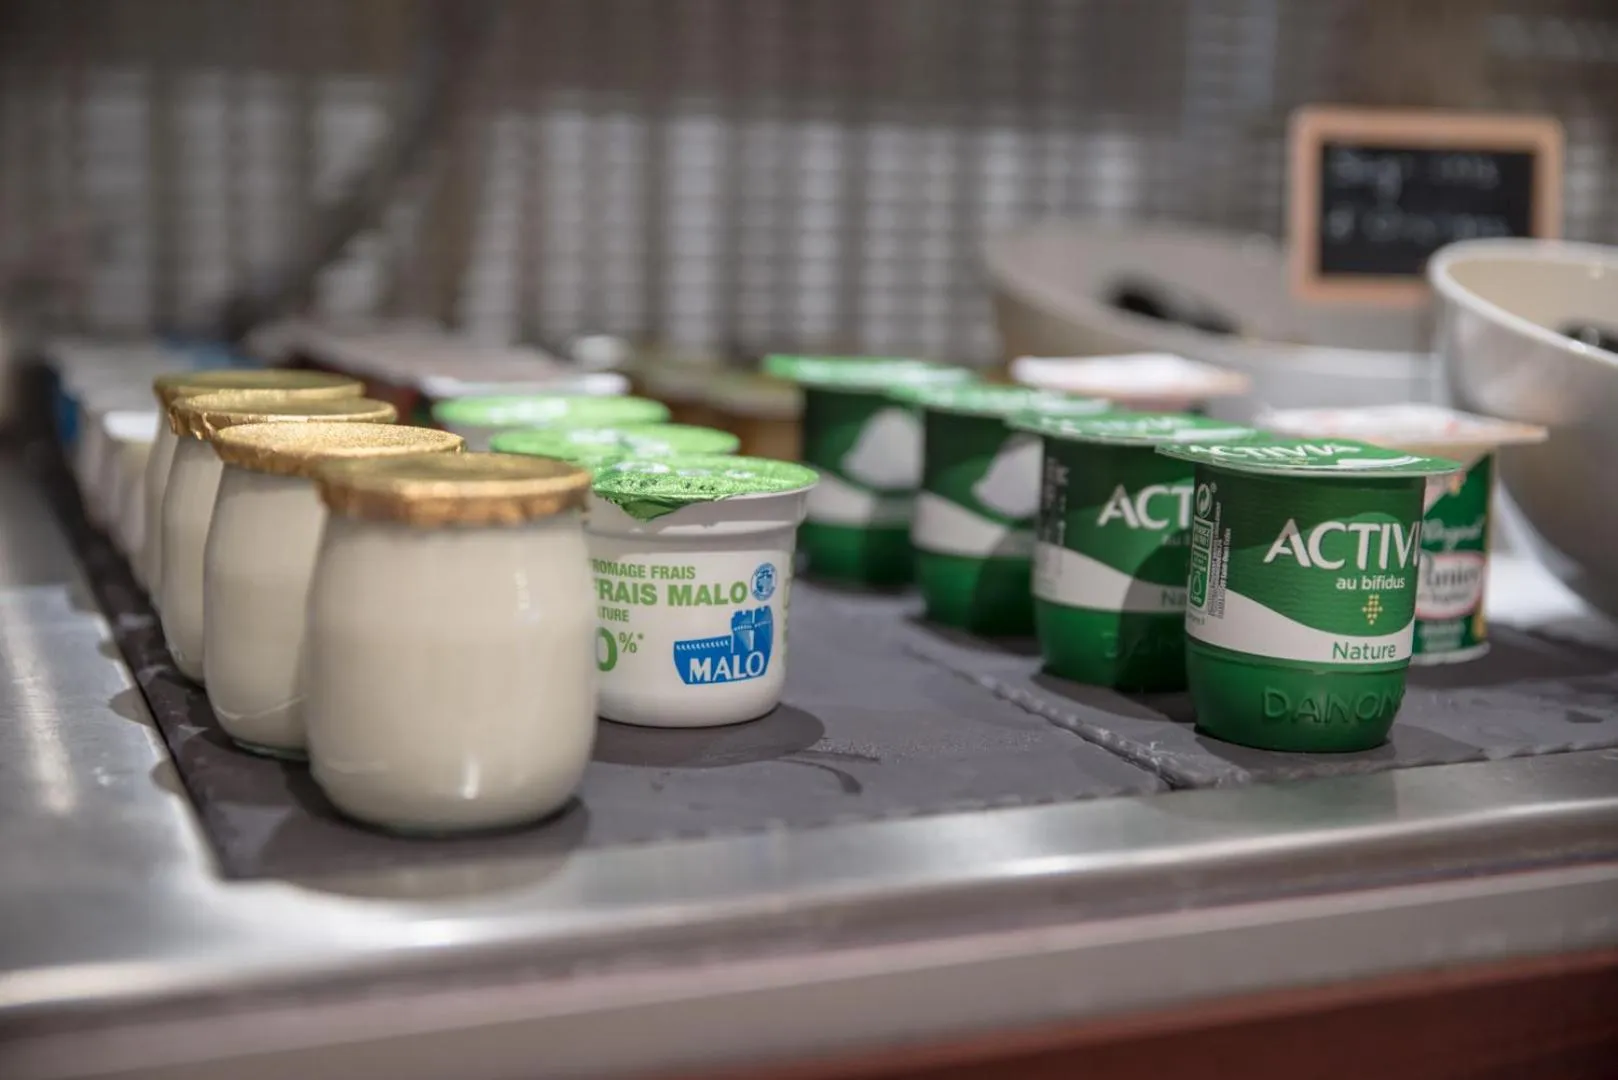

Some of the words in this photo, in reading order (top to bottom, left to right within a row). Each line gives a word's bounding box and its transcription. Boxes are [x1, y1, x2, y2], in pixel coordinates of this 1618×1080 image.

[1097, 484, 1195, 530] ACT
[591, 558, 646, 579] ROMAGE
[651, 565, 696, 580] FRAIS
[667, 581, 748, 607] MALO
[1336, 578, 1357, 591] au
[1361, 574, 1406, 591] bifidus
[597, 605, 630, 623] TURE
[1332, 641, 1397, 660] Nature
[688, 651, 765, 683] MALO
[1262, 685, 1405, 724] DANON
